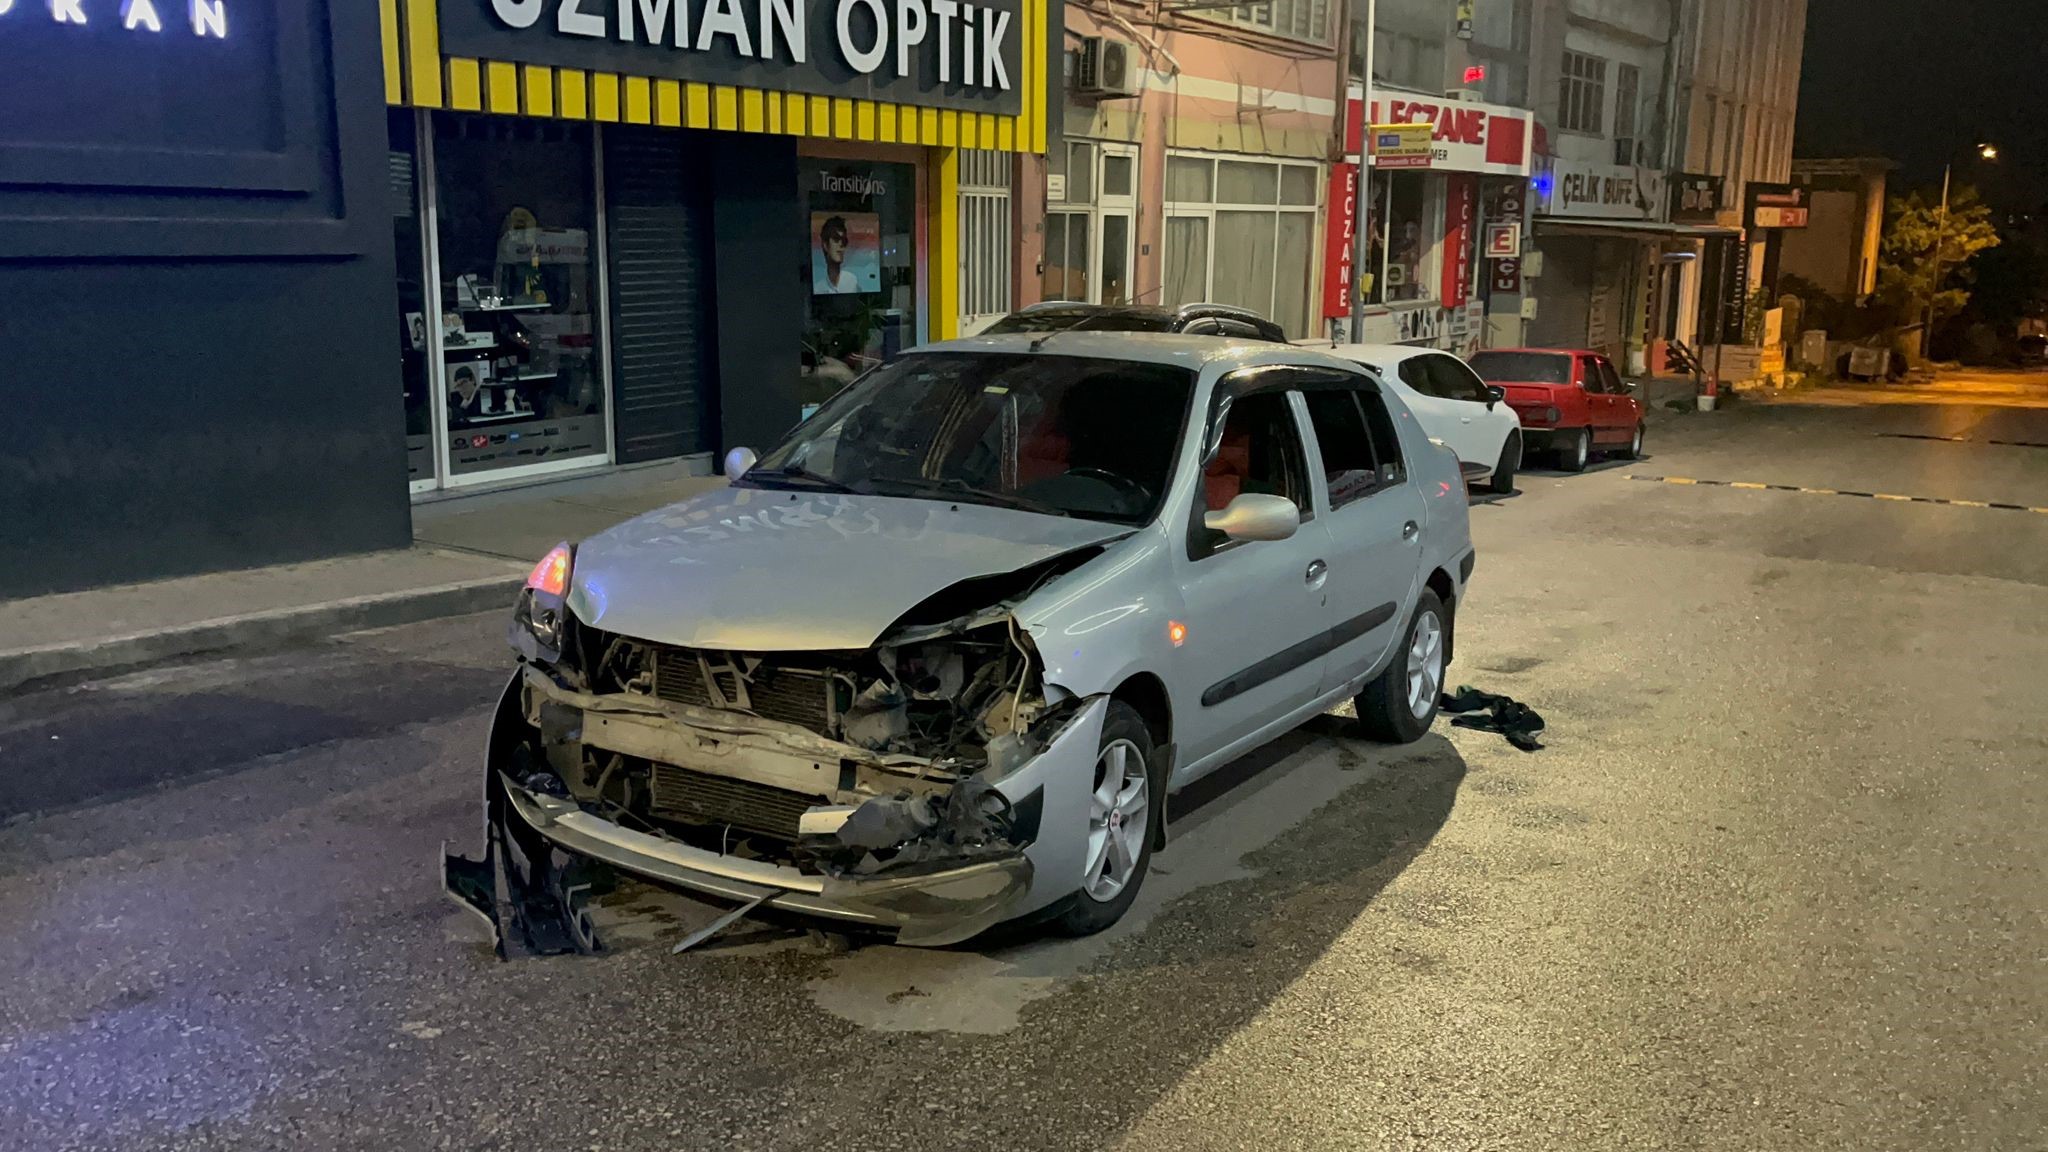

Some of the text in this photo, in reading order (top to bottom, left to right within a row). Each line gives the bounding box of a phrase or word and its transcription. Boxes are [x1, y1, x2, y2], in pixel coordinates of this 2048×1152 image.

[0, 0, 225, 38] RAN
[492, 0, 806, 63] MAN
[1390, 100, 1486, 145] ECZANE
[819, 170, 888, 204] Transitions
[1562, 168, 1601, 210] ÇELİK
[1339, 173, 1353, 307] ECZANE
[1458, 184, 1469, 299] ECZANE
